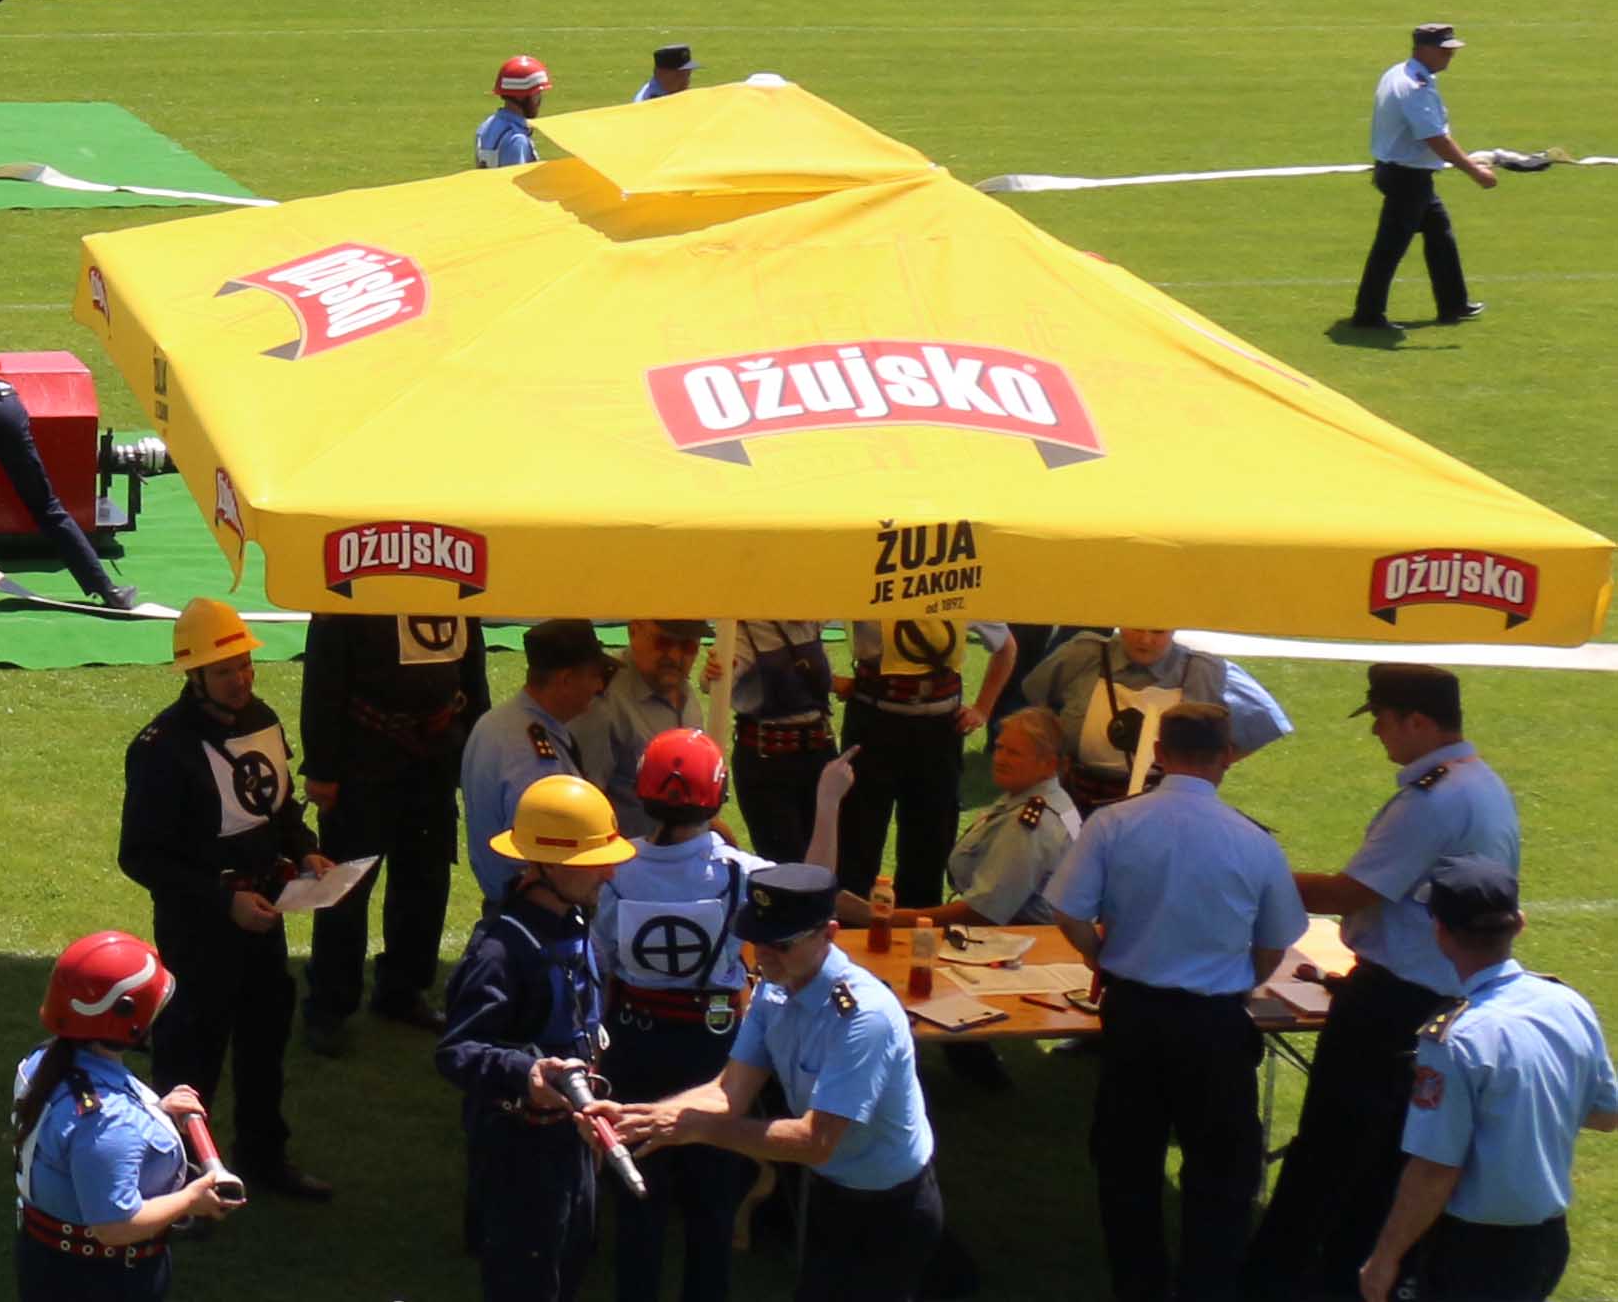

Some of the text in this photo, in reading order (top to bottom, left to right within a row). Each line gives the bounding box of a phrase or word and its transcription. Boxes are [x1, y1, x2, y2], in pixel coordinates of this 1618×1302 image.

[683, 346, 1058, 430] Ožujsko
[338, 525, 474, 574] Ožujsko
[875, 518, 977, 575] ŽUJA
[870, 565, 982, 604] JE ZAKON!
[1384, 553, 1524, 604] Ožujsko
